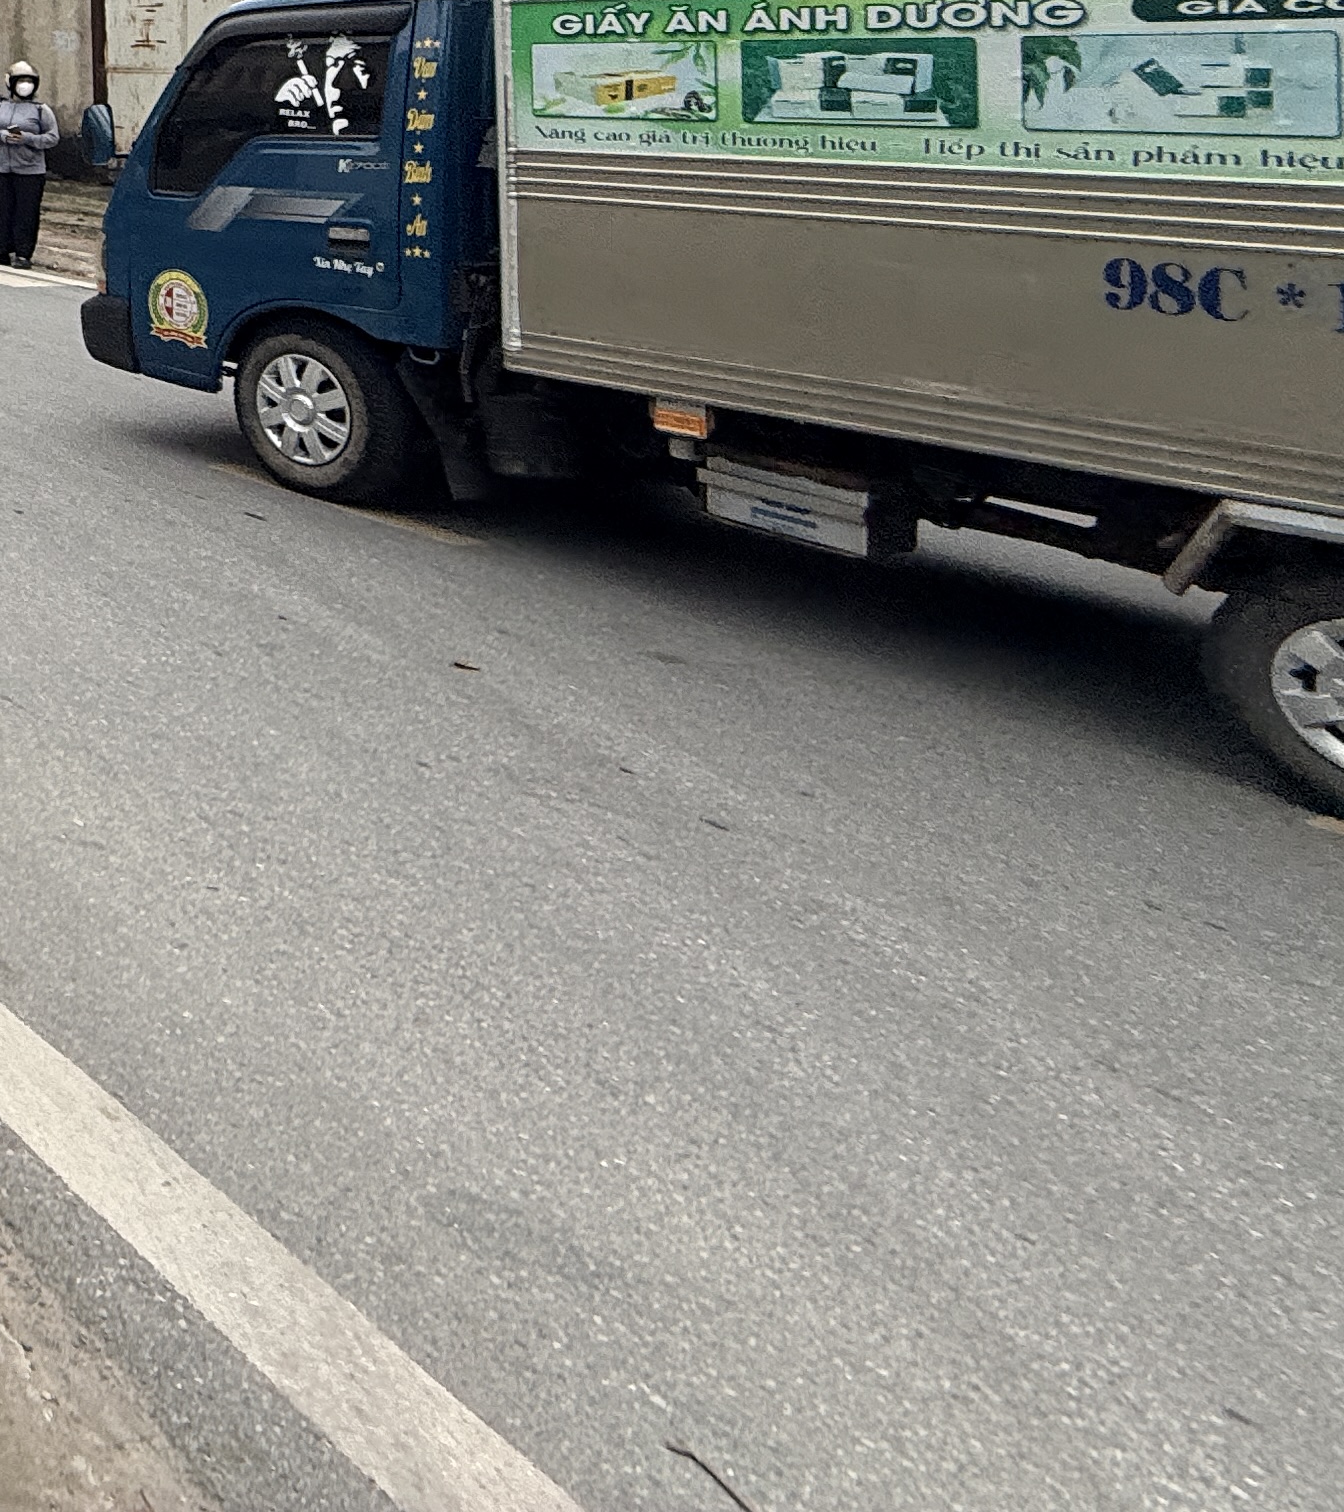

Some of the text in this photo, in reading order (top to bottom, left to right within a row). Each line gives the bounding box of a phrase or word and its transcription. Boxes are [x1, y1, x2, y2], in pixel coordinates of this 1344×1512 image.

[551, 2, 652, 36] GIẤY
[664, 3, 730, 33] ĂN
[743, 0, 850, 33] ÁNH
[278, 108, 311, 119] RELAX
[593, 130, 631, 142] cao
[1102, 257, 1250, 322] 98C
